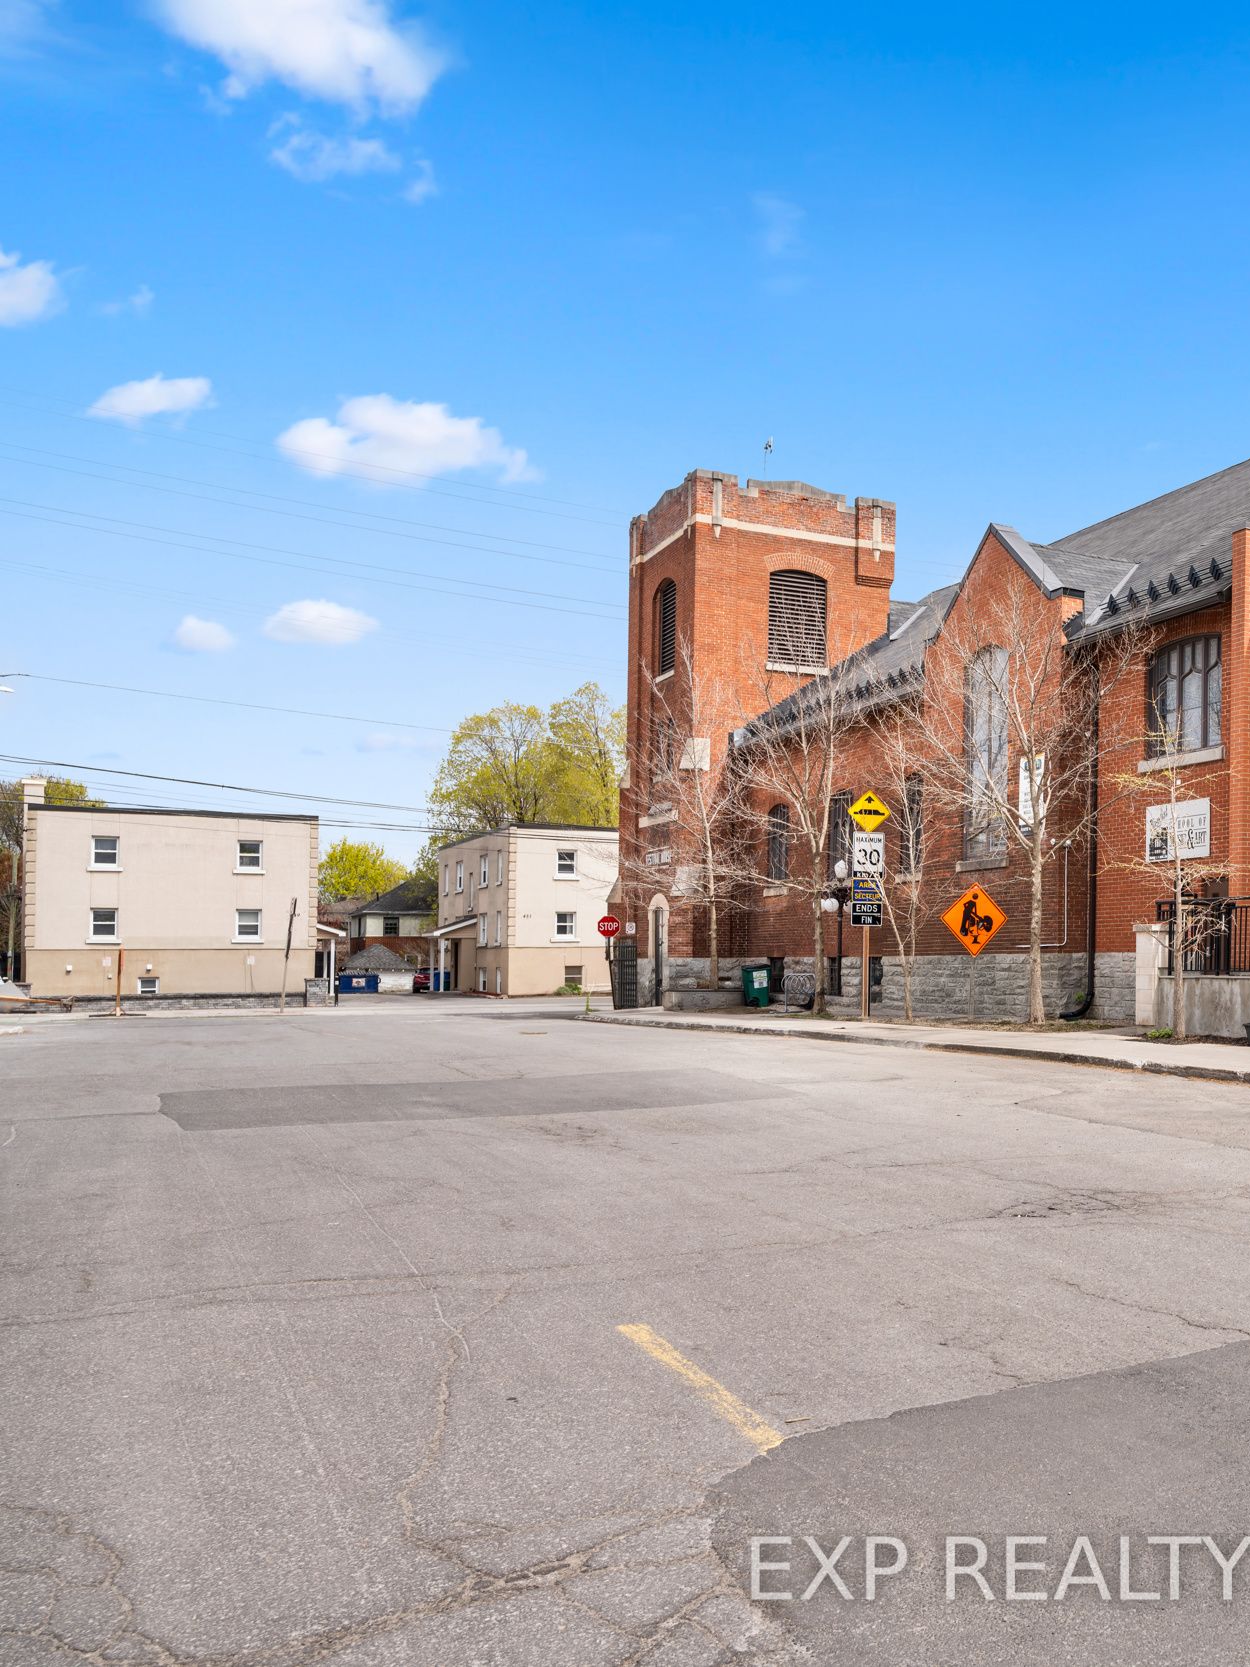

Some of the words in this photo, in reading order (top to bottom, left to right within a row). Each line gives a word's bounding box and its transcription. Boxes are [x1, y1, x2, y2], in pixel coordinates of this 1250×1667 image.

[856, 836, 882, 844] MAXIMUM
[857, 848, 881, 866] 30
[855, 903, 878, 913] ENDS
[861, 915, 873, 924] FIN
[599, 922, 619, 931] STOP
